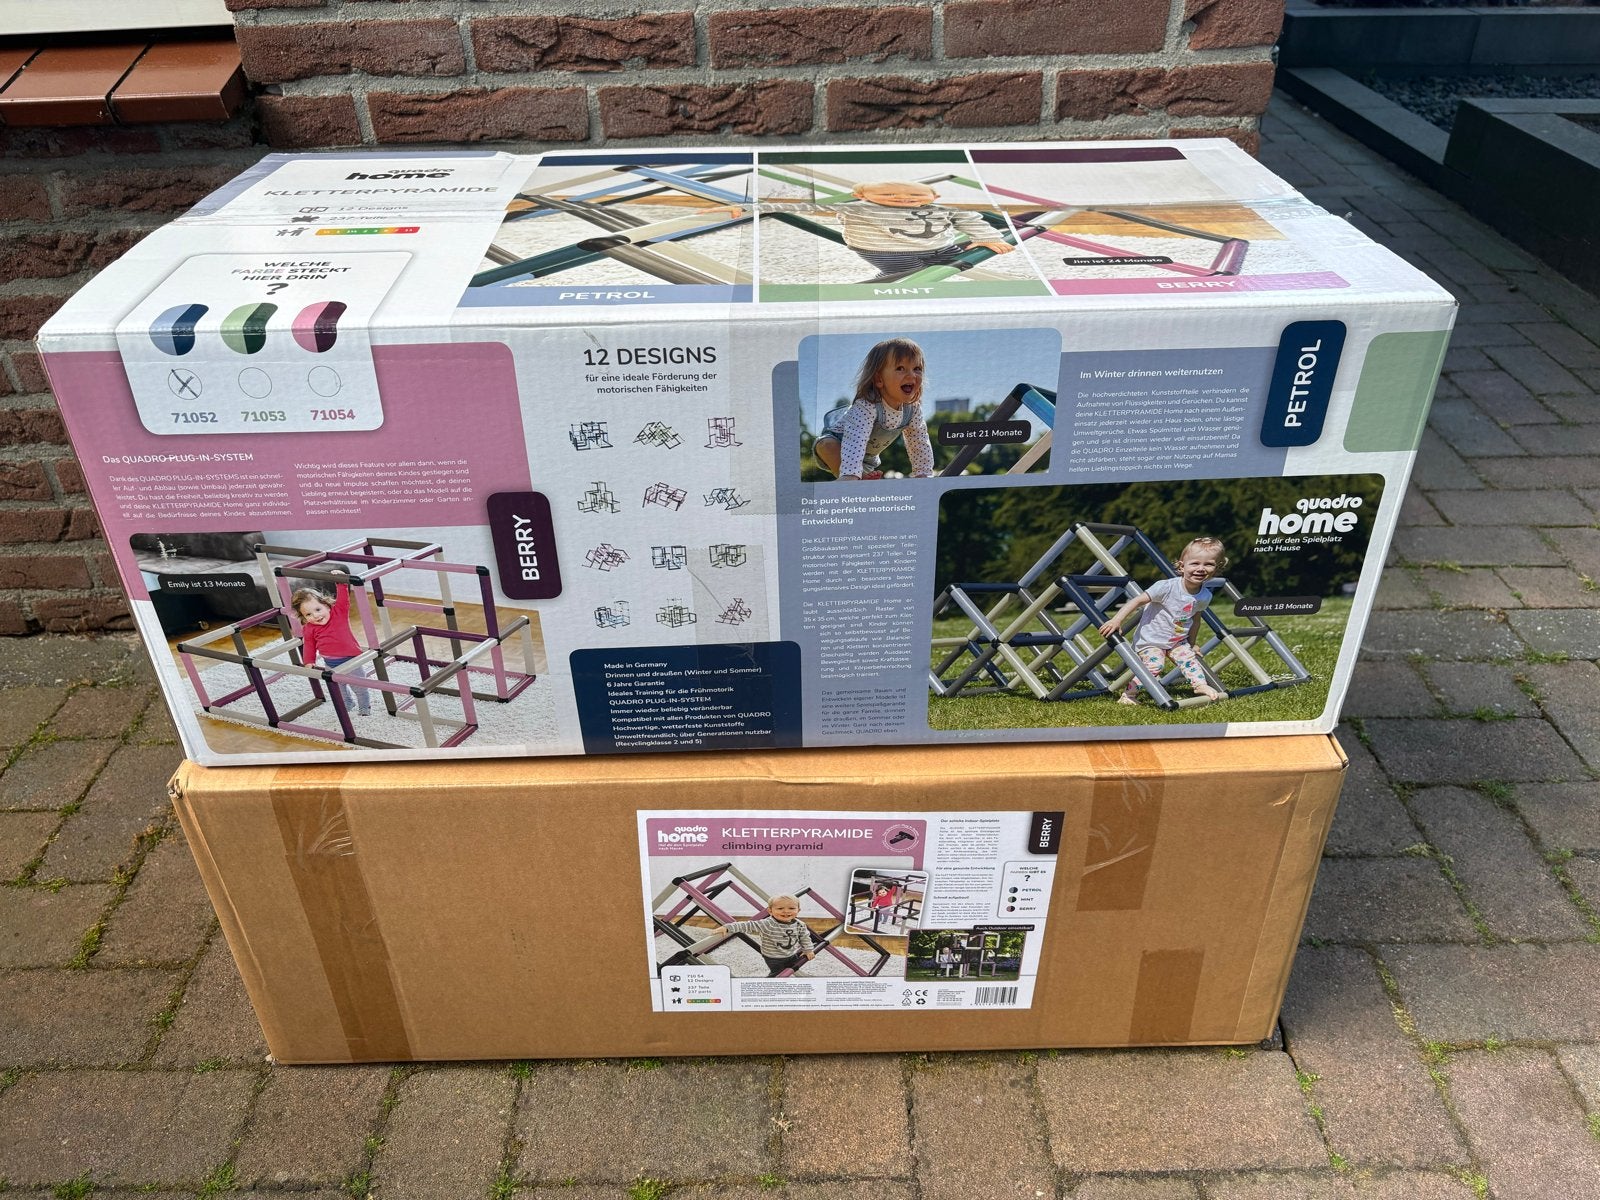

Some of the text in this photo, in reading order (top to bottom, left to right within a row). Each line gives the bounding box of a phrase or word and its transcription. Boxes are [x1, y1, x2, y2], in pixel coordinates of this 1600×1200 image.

[345, 172, 450, 180] home
[264, 186, 498, 196] KLETTERPYRAMIDE
[264, 260, 331, 268] WELCHE
[1156, 280, 1237, 289] BERRY
[559, 290, 655, 301] PETROL
[873, 287, 934, 295] MINT
[583, 346, 717, 366] 12 DESIGNS
[585, 371, 717, 383] für eine ideale Förderung der
[1094, 370, 1125, 378] Winter
[1128, 369, 1162, 377] drinnen
[1164, 368, 1223, 376] weiternutzen
[1284, 338, 1322, 427] PETROL
[597, 383, 708, 394] motorischen Fähigkeiten
[171, 409, 355, 424] 71052 71053 71054
[946, 431, 964, 439] Lara
[992, 429, 1022, 437] Monate
[820, 498, 839, 506] pure
[842, 495, 912, 504] Kletterabenteuer
[1296, 494, 1363, 514] quadro
[831, 506, 866, 516] perfekte
[869, 504, 915, 512] motorische
[802, 517, 853, 525] Entwicklung
[1258, 508, 1358, 535] home
[512, 514, 540, 581] BERRY
[167, 579, 246, 590] Emily ist 13 Monate
[635, 689, 664, 697] Training
[645, 696, 711, 704] PLUG-IN-SYSTEM
[661, 706, 689, 714] beliebig
[612, 716, 652, 724] Kompatibel
[674, 825, 708, 833] quadro
[722, 827, 873, 839] KLETTERPYRAMIDE
[1039, 818, 1053, 847] BERRY
[658, 830, 708, 842] home
[722, 842, 823, 851] climbing pyramid
